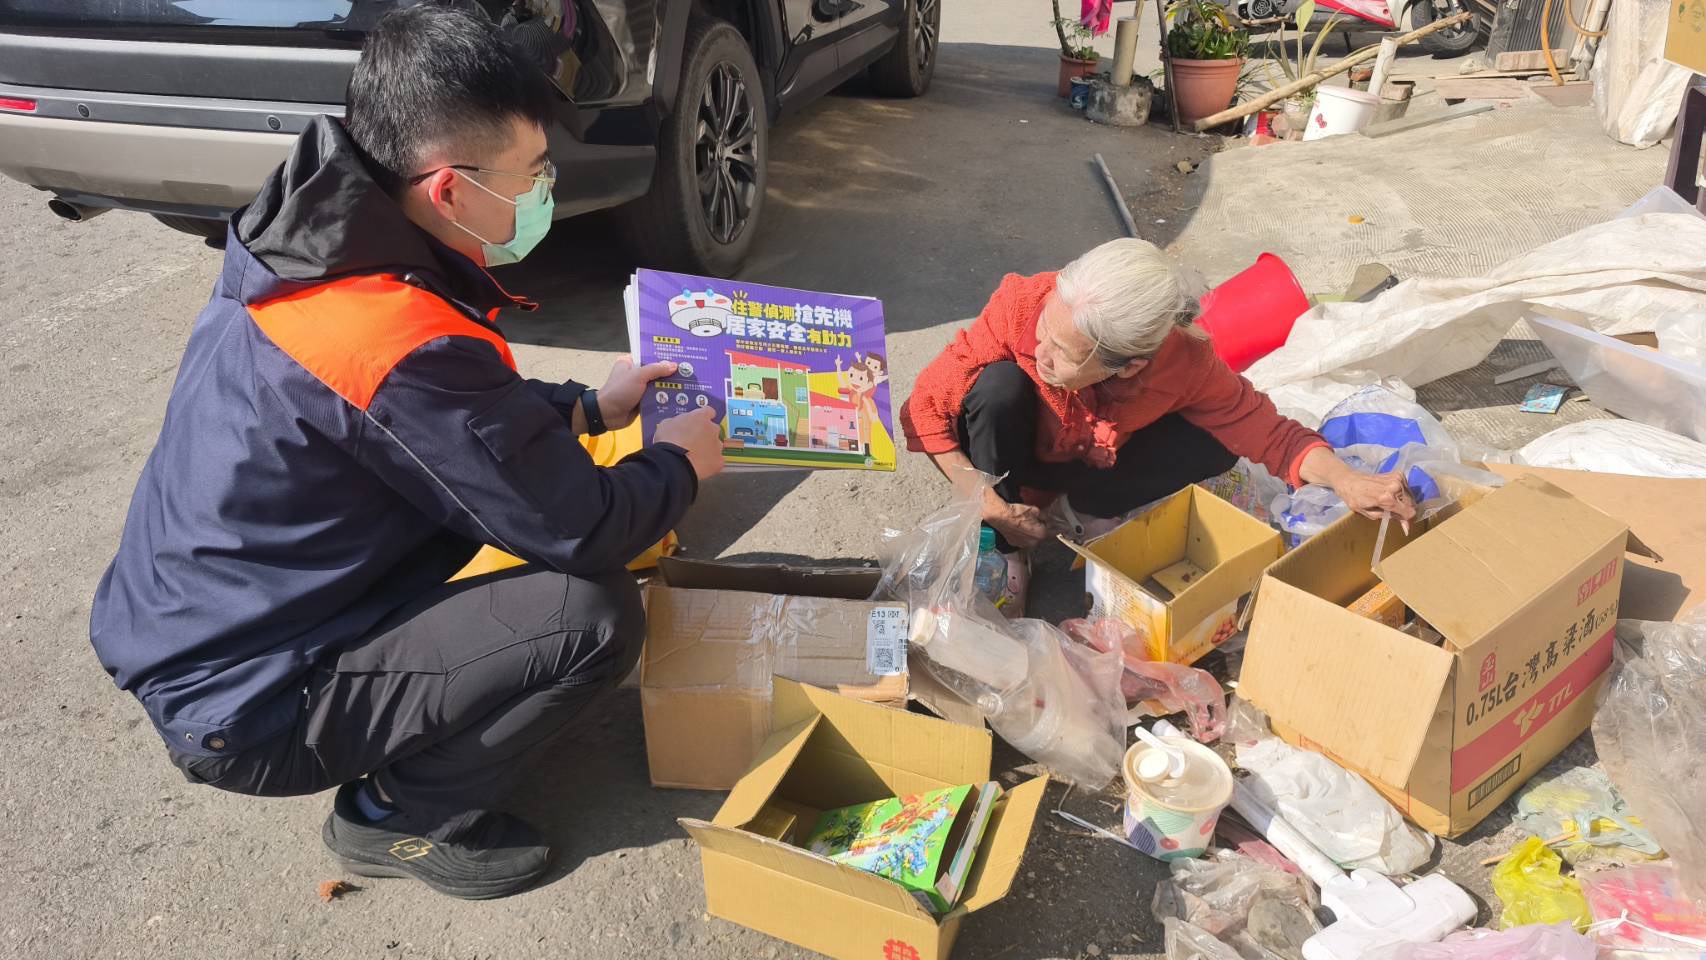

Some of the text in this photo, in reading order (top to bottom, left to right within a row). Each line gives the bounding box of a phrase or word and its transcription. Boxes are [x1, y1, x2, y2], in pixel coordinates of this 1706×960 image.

[732, 299, 853, 329] 住警偵測搶先機
[1549, 681, 1573, 713] TTL
